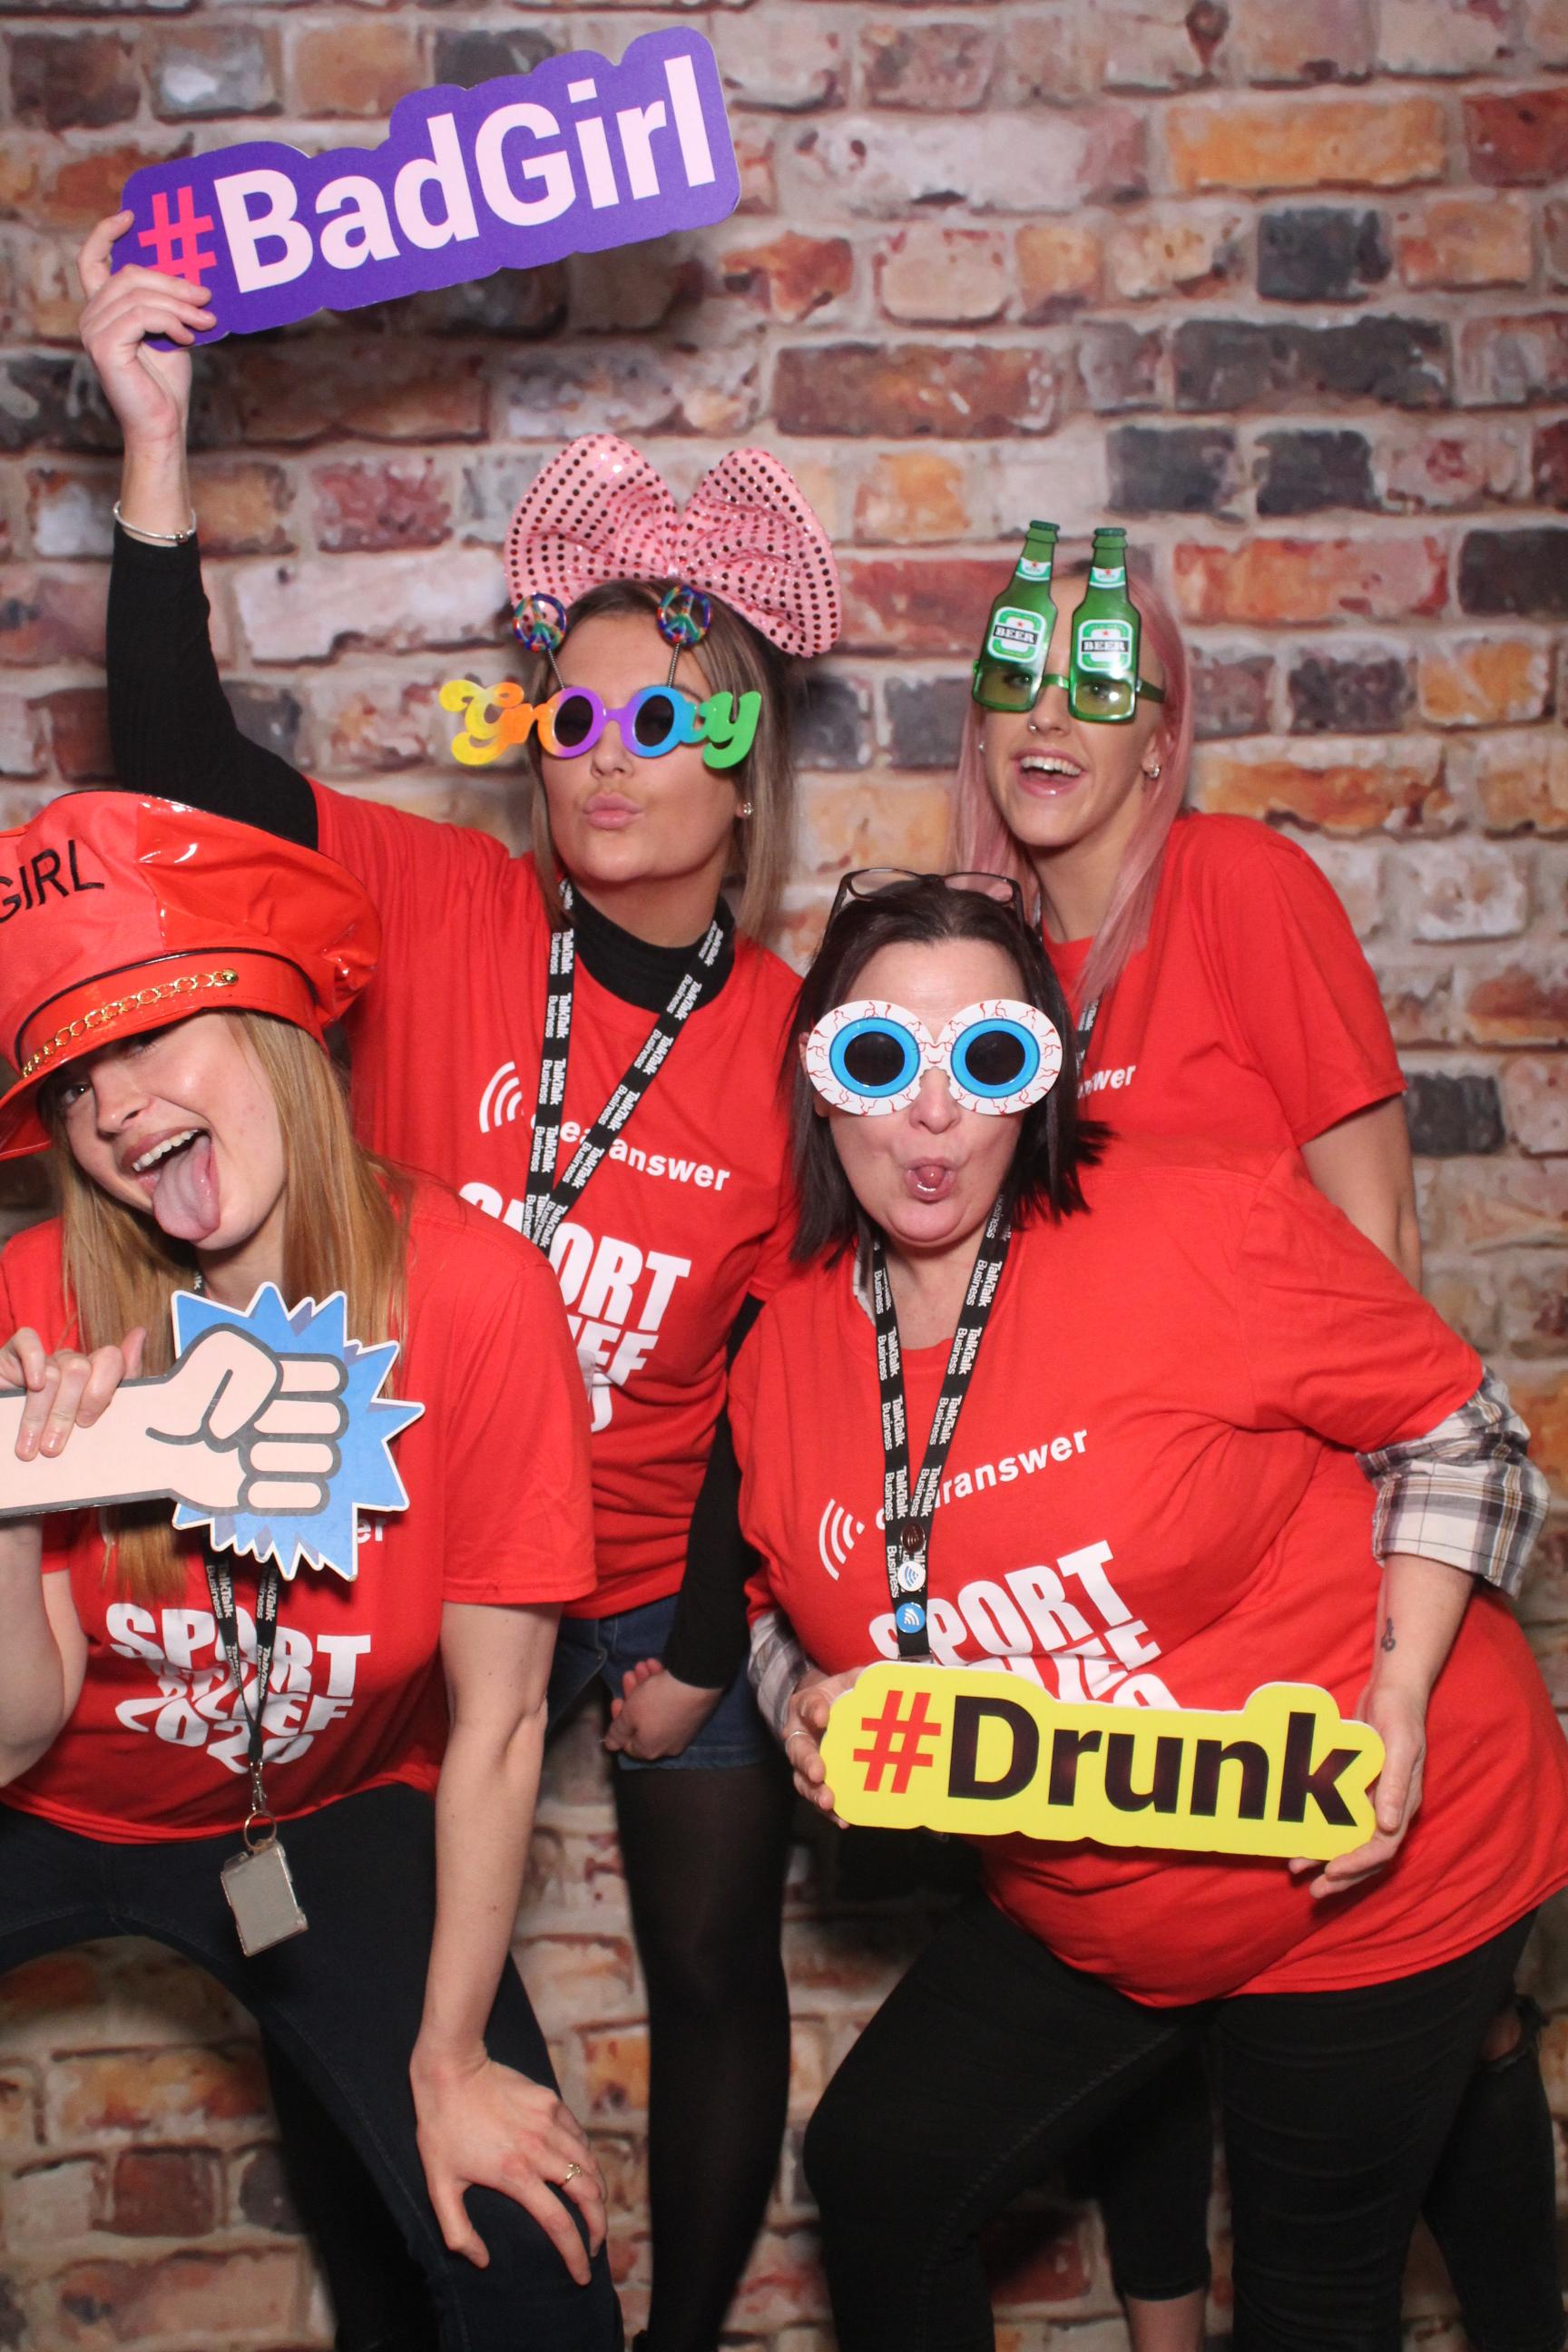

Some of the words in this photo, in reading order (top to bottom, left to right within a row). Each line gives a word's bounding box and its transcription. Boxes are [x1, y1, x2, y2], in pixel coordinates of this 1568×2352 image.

[137, 54, 717, 294] #BadGirl
[995, 626, 1035, 643] BEER
[1083, 640, 1126, 652] BEER
[544, 995, 558, 1038] Business
[556, 993, 573, 1039] TalkTalk
[633, 1028, 662, 1069] Business
[642, 1035, 674, 1075] TalkTalk
[538, 1059, 554, 1104] Business
[550, 1058, 567, 1105] TalkTalk
[598, 1084, 628, 1125] Business
[607, 1090, 641, 1132] TalkTalk
[530, 1126, 545, 1172] Business
[542, 1125, 559, 1173] TalkTalk
[562, 1142, 593, 1183] Business
[571, 1146, 605, 1189] TalkTalk
[874, 1270, 884, 1315] Business
[965, 1259, 988, 1306] Business
[978, 1261, 1003, 1308] TalkTalk
[877, 1335, 887, 1381] Business
[887, 1326, 900, 1377] TalkTalk
[947, 1328, 968, 1375] Business
[958, 1327, 983, 1376] TalkTalk
[882, 1402, 893, 1451] Business
[892, 1395, 906, 1447] TalkTalk
[929, 1397, 949, 1446] Business
[938, 1396, 963, 1445] TalkTalk
[885, 1472, 895, 1521] Business
[895, 1465, 908, 1519] TalkTalk
[910, 1468, 930, 1517] Business
[920, 1465, 942, 1517] TalkTalk
[887, 1545, 899, 1599] Business
[852, 1689, 1362, 1828] #Drunk
